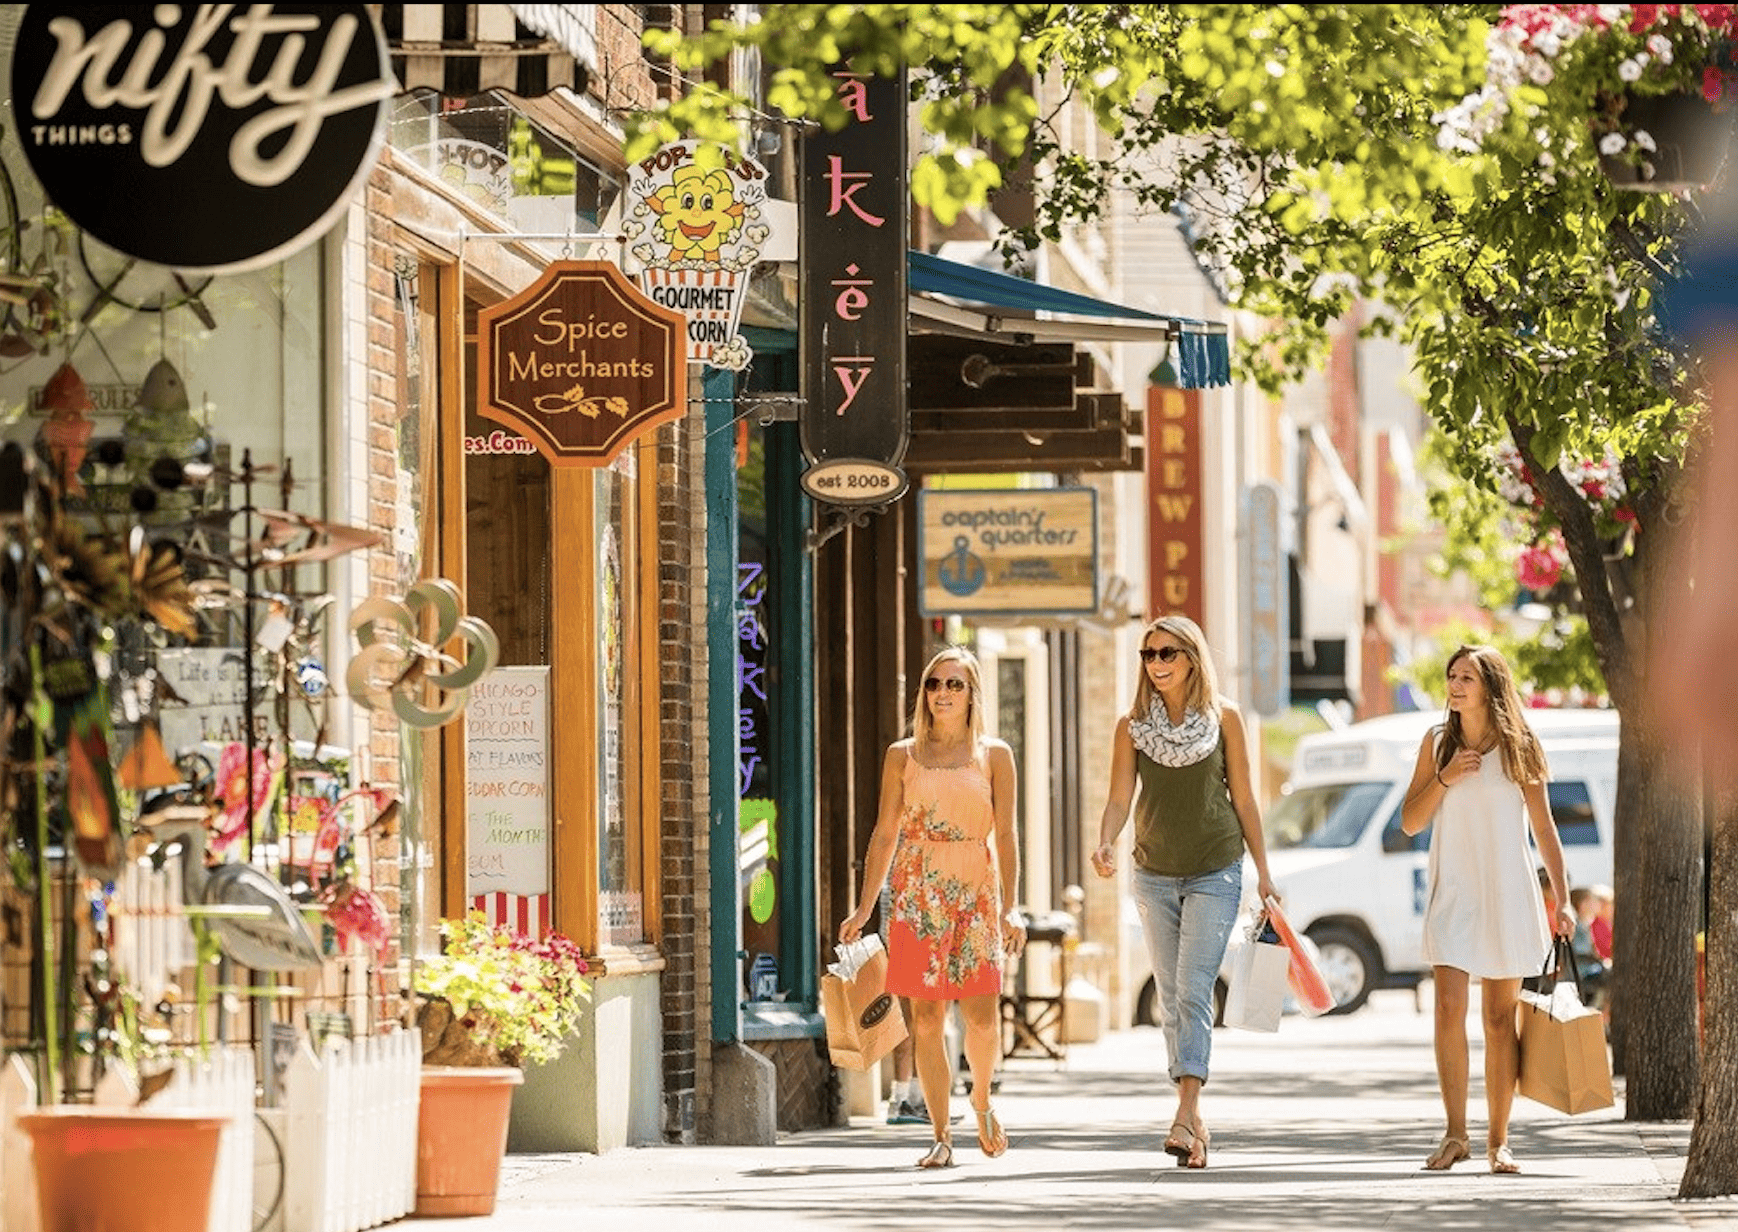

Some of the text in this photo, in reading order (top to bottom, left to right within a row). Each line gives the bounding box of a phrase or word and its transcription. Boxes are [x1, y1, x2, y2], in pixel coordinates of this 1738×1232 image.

[33, 4, 403, 187] nifty
[31, 123, 133, 146] THINGS
[653, 286, 735, 311] GOURMET
[533, 307, 628, 353] Spice
[688, 320, 728, 343] CORN
[508, 350, 655, 382] Merchants
[816, 473, 891, 489] est 2008
[1157, 388, 1193, 617] BREW PU
[980, 529, 1078, 552] quarters
[471, 682, 545, 699] HICAGO-
[473, 700, 532, 718] STYLE
[468, 720, 534, 736] OPCORN
[485, 808, 513, 827] THE
